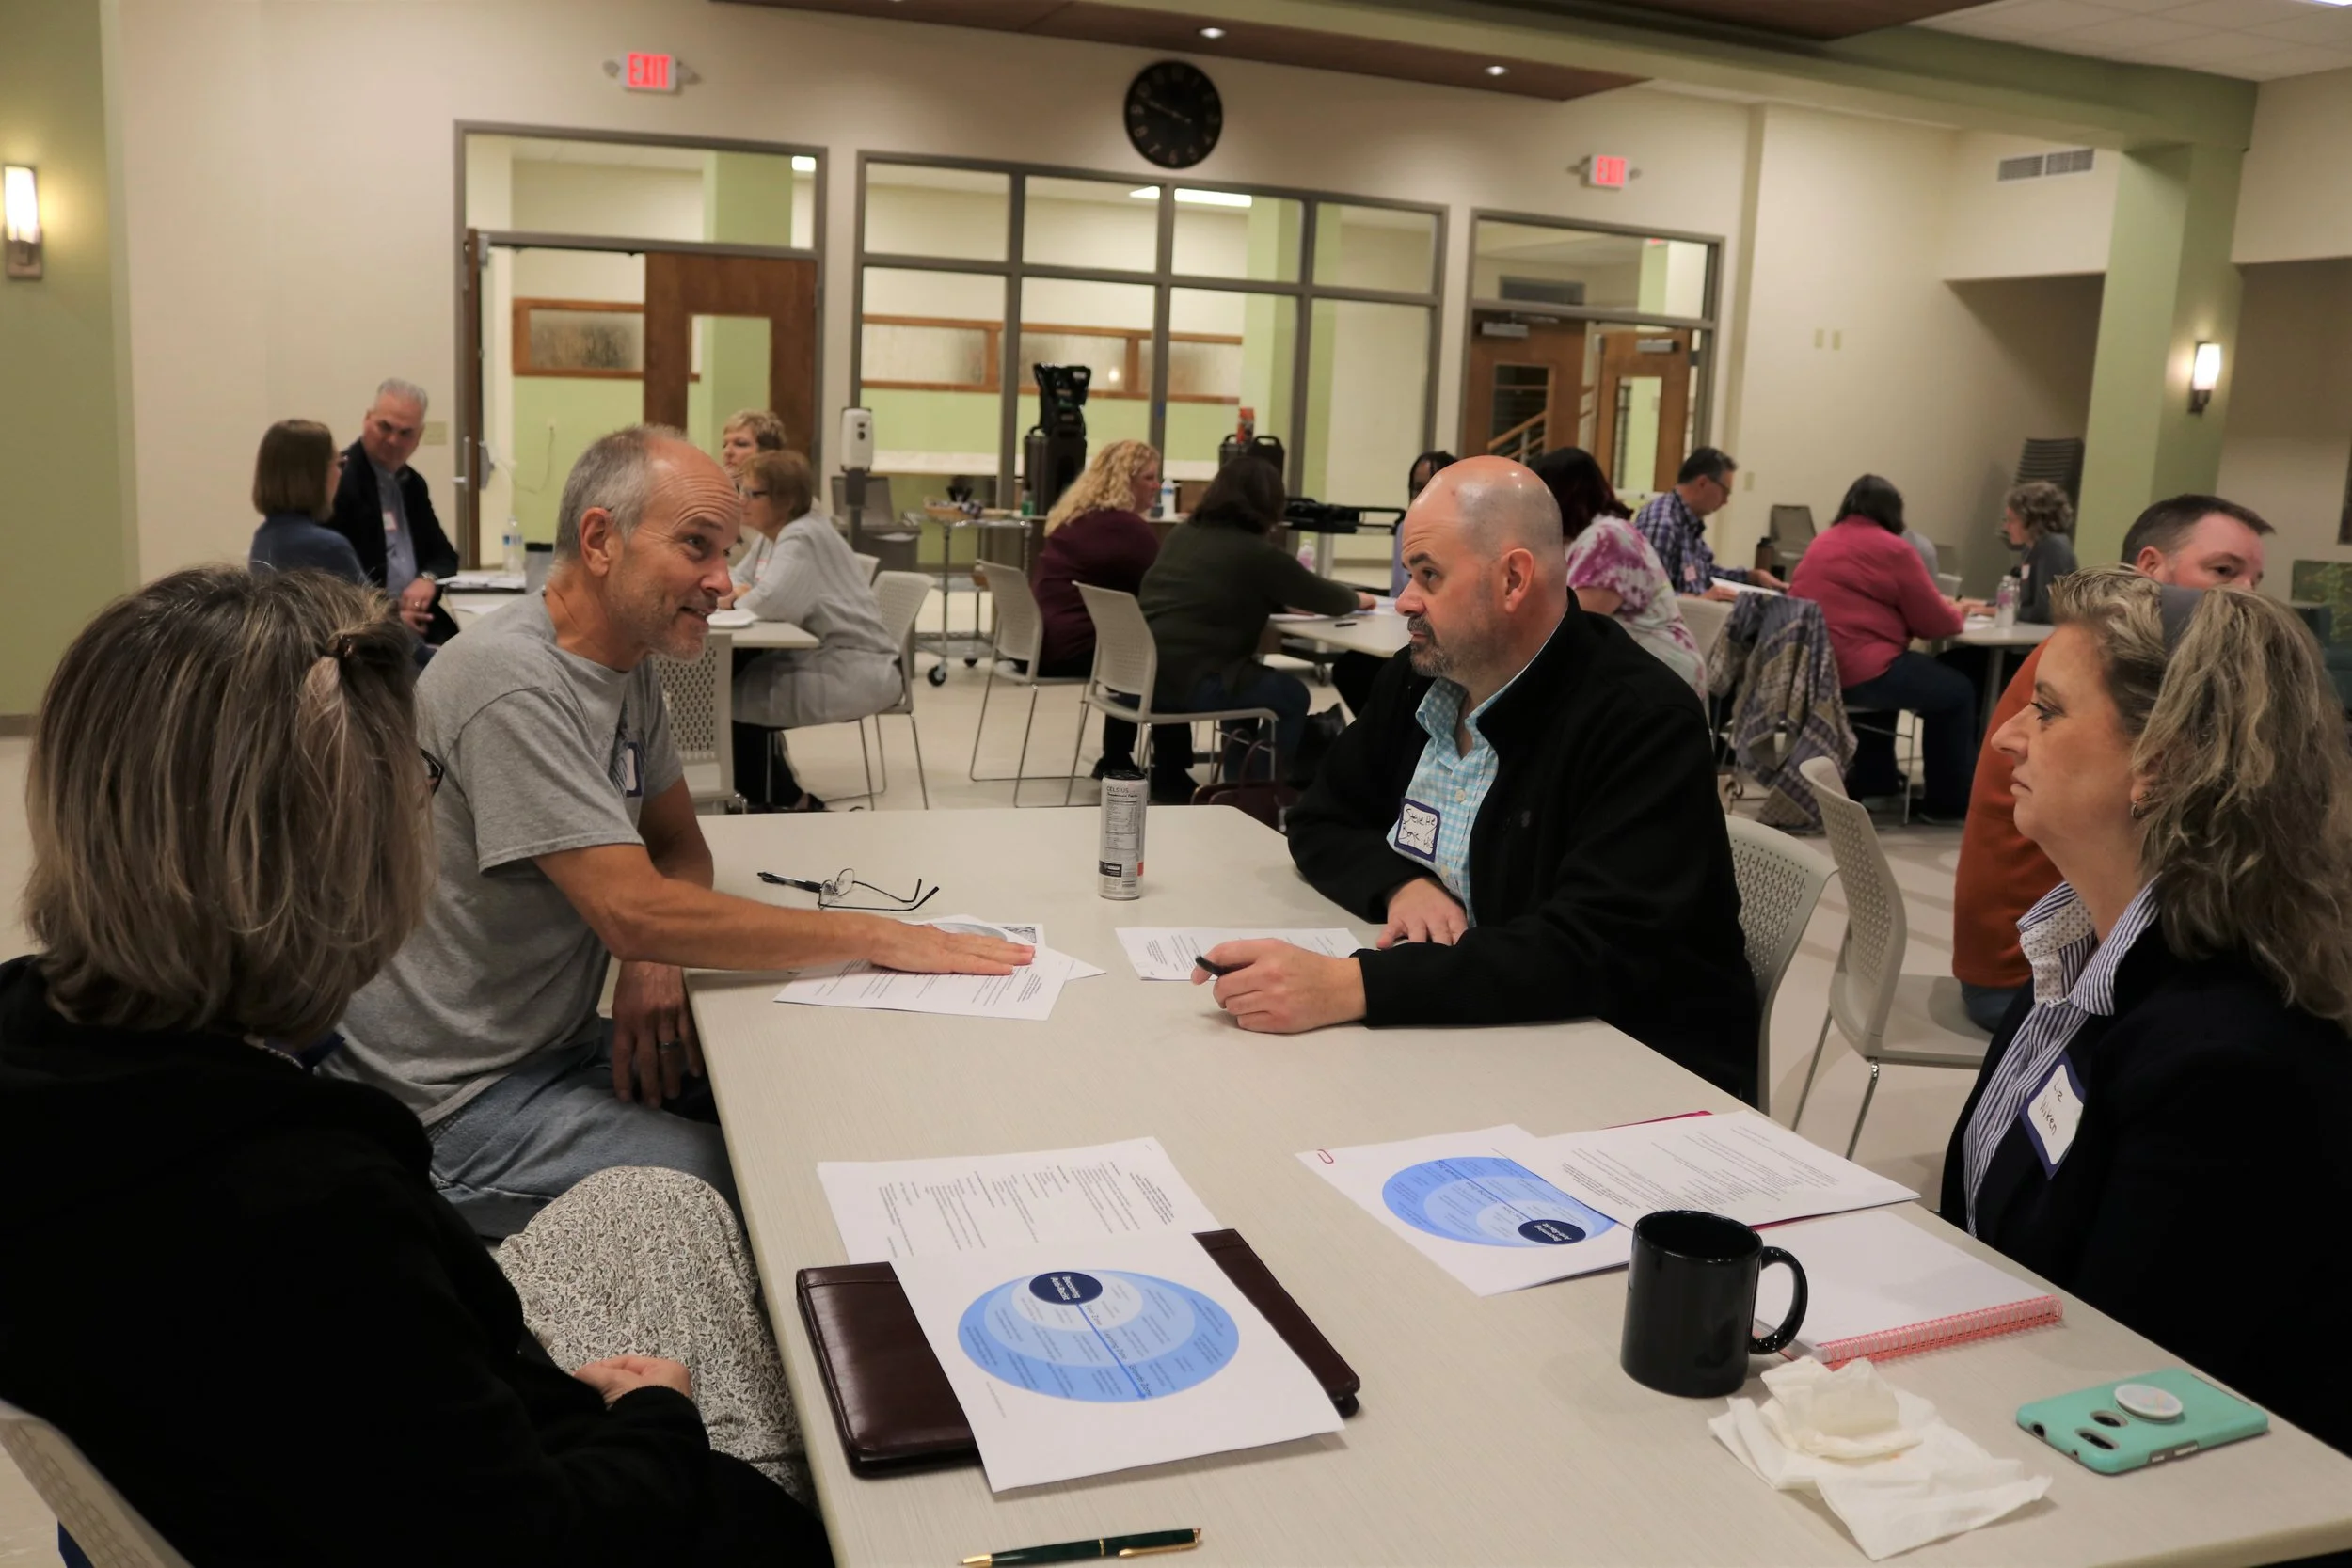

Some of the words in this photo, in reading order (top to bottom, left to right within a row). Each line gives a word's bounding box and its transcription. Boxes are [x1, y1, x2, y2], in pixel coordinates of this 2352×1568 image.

[628, 52, 671, 89] EXIT
[1596, 155, 1625, 187] EXIT
[1106, 785, 1130, 794] CELSIUS
[1050, 1277, 1070, 1300] Anti-Racist
[1062, 1276, 1081, 1298] Becoming
[1128, 1363, 1145, 1384] Growth
